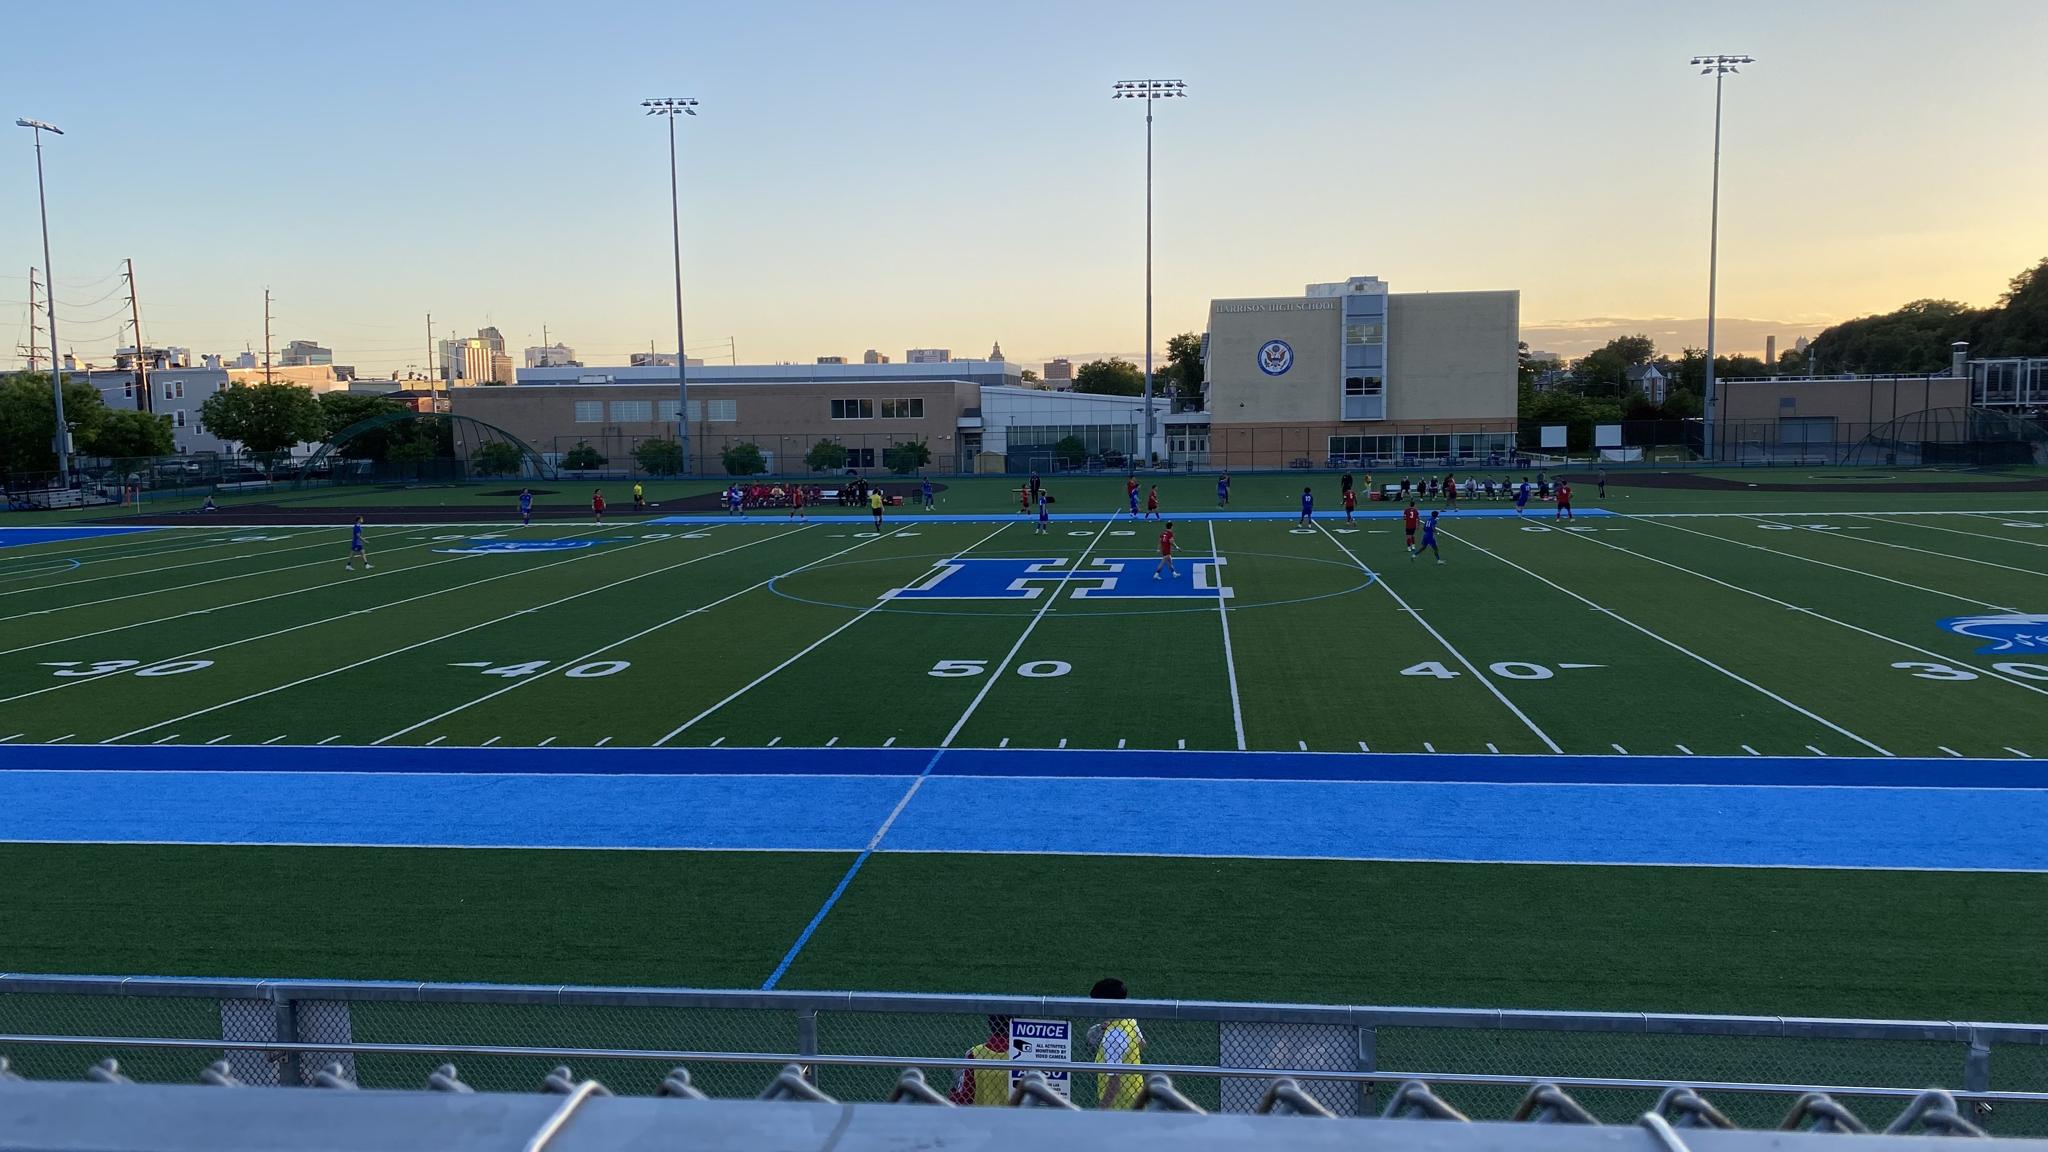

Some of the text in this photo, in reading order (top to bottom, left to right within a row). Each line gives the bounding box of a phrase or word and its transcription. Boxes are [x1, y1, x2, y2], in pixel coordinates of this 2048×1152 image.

[1216, 301, 1337, 313] HARRISON HIGH SCHOOL
[1017, 1024, 1064, 1037] NOTICE
